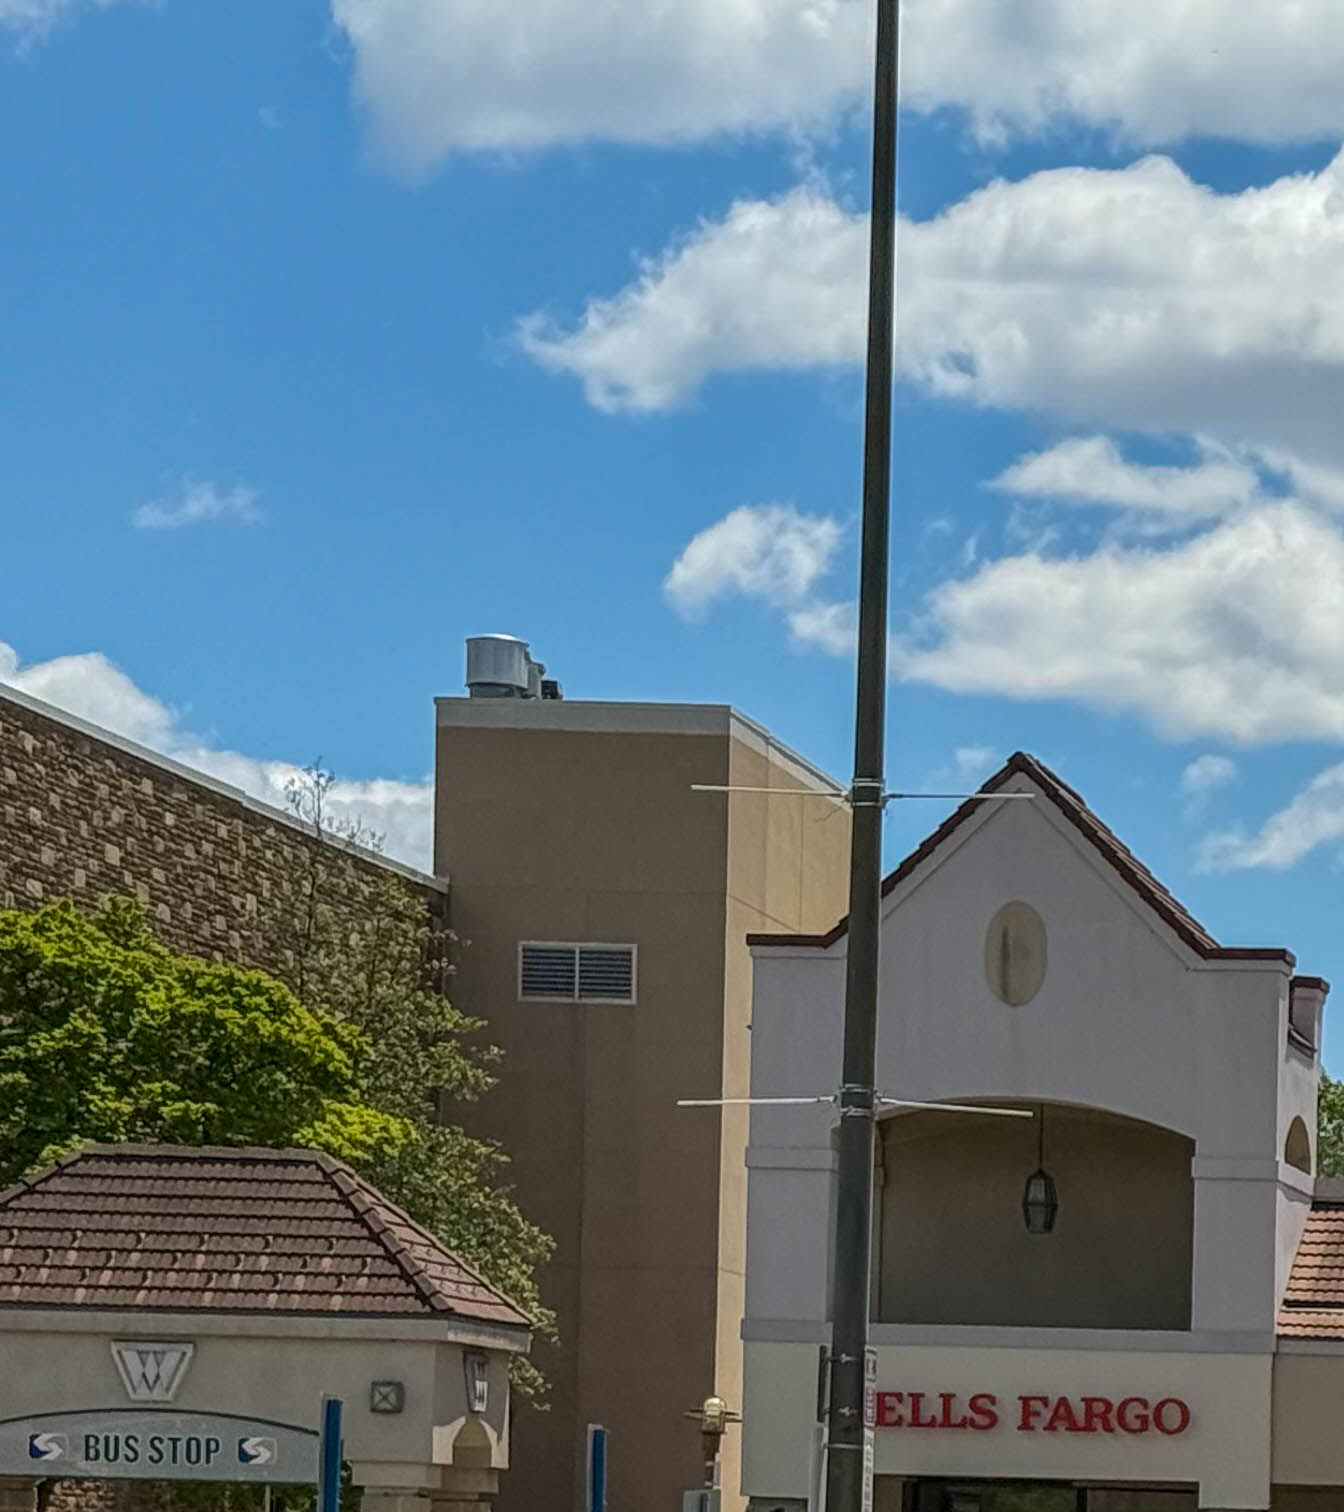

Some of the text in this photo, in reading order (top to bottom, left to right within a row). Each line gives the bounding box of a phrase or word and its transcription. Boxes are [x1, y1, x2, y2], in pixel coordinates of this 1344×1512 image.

[875, 1392, 1191, 1435] ELLS FARGO
[84, 1432, 221, 1465] BUS STOP
